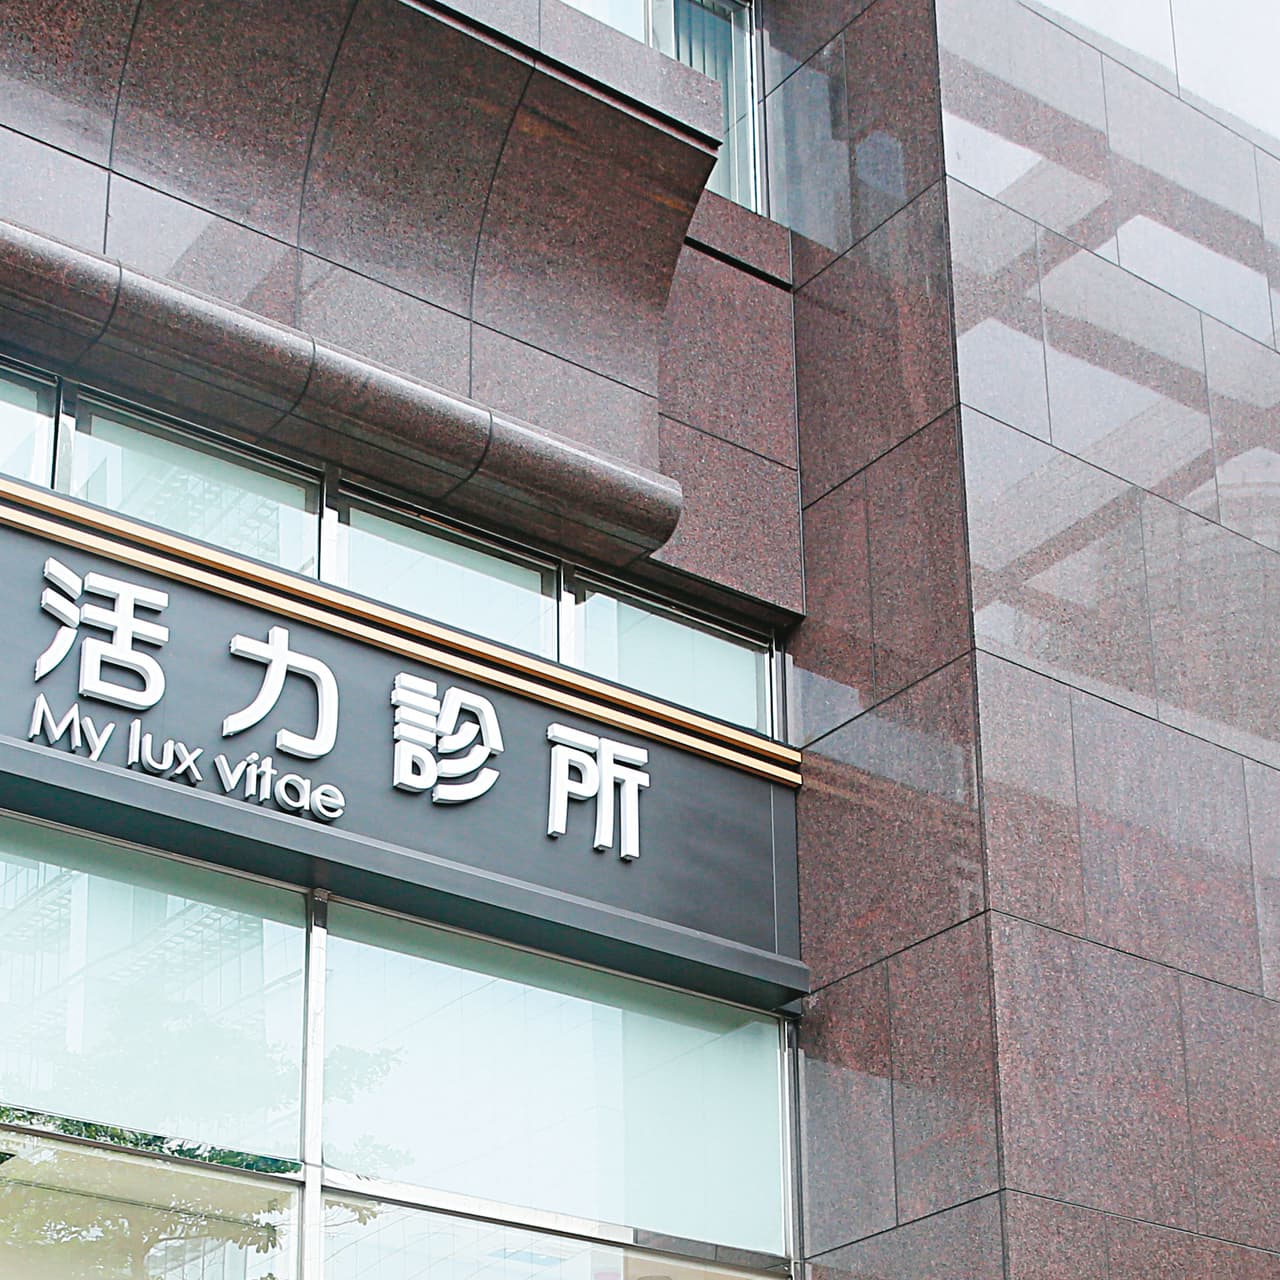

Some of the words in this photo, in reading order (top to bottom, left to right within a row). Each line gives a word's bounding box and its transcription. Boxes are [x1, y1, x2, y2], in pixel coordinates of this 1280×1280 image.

[28, 692, 117, 761] My
[127, 718, 204, 784] lux
[214, 752, 346, 822] vitae
